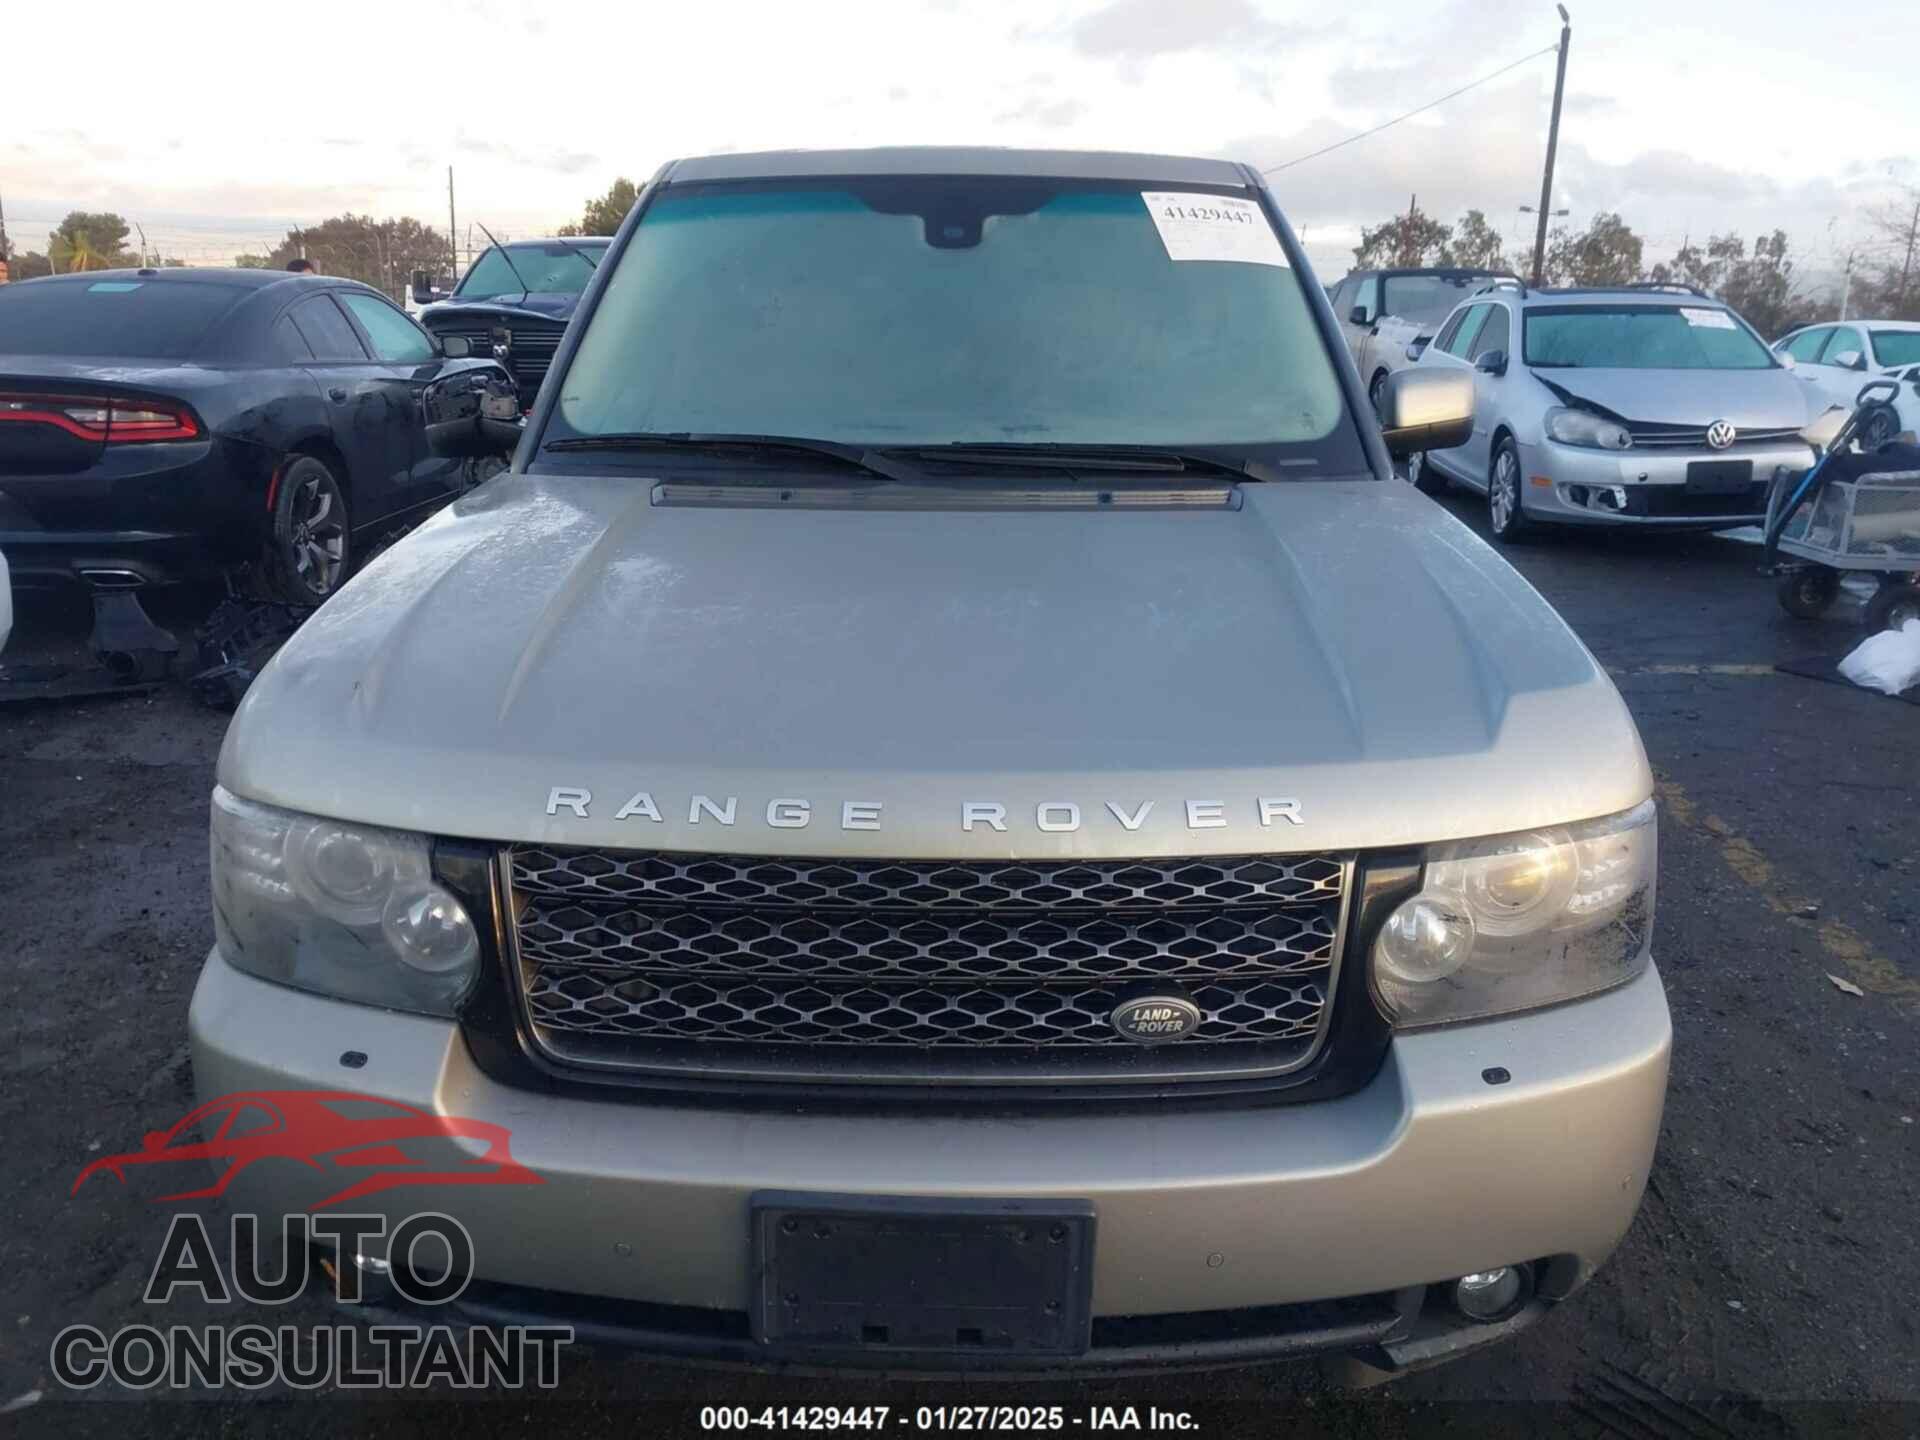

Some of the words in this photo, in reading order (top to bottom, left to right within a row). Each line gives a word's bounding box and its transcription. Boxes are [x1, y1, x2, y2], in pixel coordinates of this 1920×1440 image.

[1163, 206, 1253, 225] 41429447
[546, 785, 883, 831] RANGE
[962, 795, 1305, 833] ROVER
